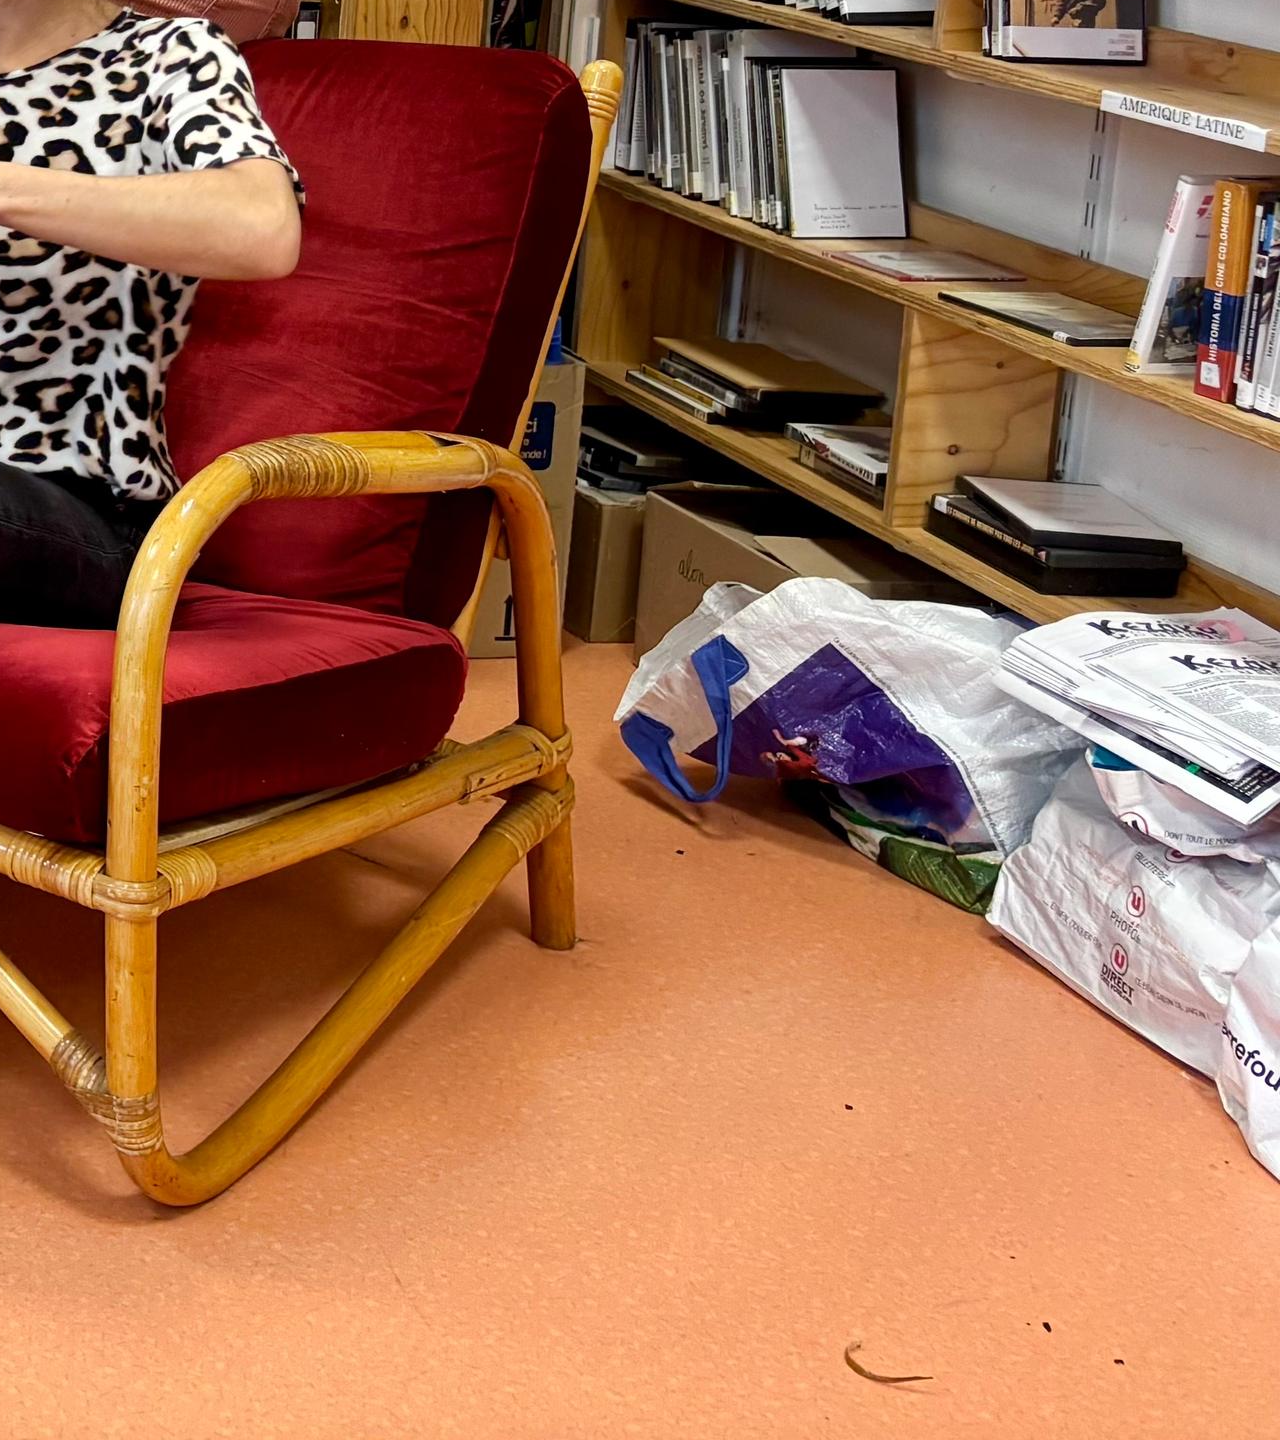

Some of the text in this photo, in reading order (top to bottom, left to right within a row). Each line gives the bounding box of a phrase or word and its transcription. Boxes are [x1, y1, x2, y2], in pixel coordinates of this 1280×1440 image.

[1119, 97, 1245, 140] AMERIQUE LATINE
[1206, 190, 1232, 361] HISTORIA DEL CINE COLOMBIANO
[1101, 963, 1135, 998] DIRECT
